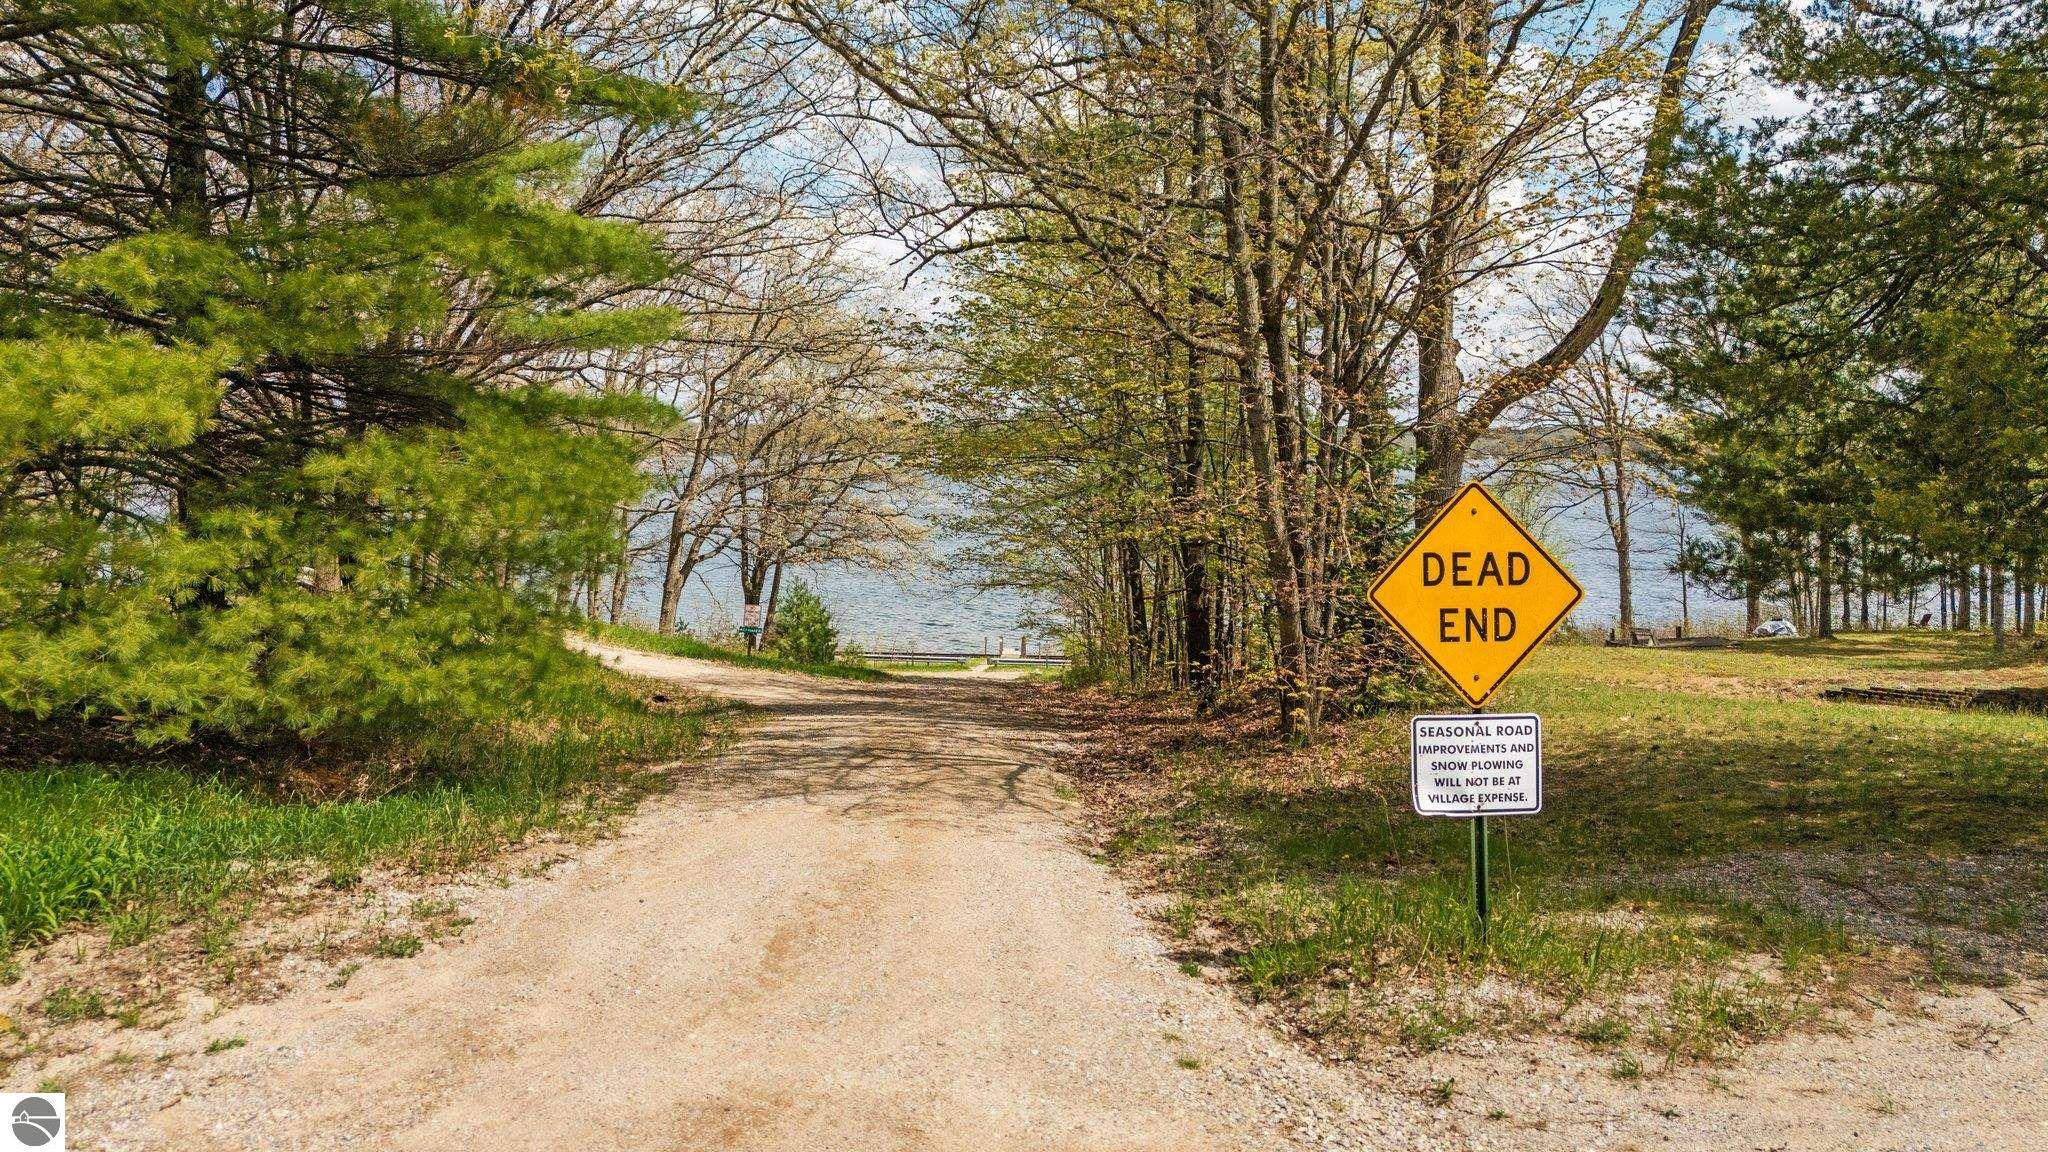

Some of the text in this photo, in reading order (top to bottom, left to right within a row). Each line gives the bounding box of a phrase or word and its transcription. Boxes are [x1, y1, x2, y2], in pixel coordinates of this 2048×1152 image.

[1422, 551, 1531, 586] DEAD
[1440, 607, 1517, 642] END
[1420, 725, 1533, 737] SEASONAL ROAD
[1418, 743, 1535, 755] IMPROVEMENTS AND
[1431, 760, 1524, 771] SNOW PLOWING
[1434, 776, 1521, 787] WILL NOT BE AT
[1428, 792, 1528, 804] VILLAGE EXPENSE.
